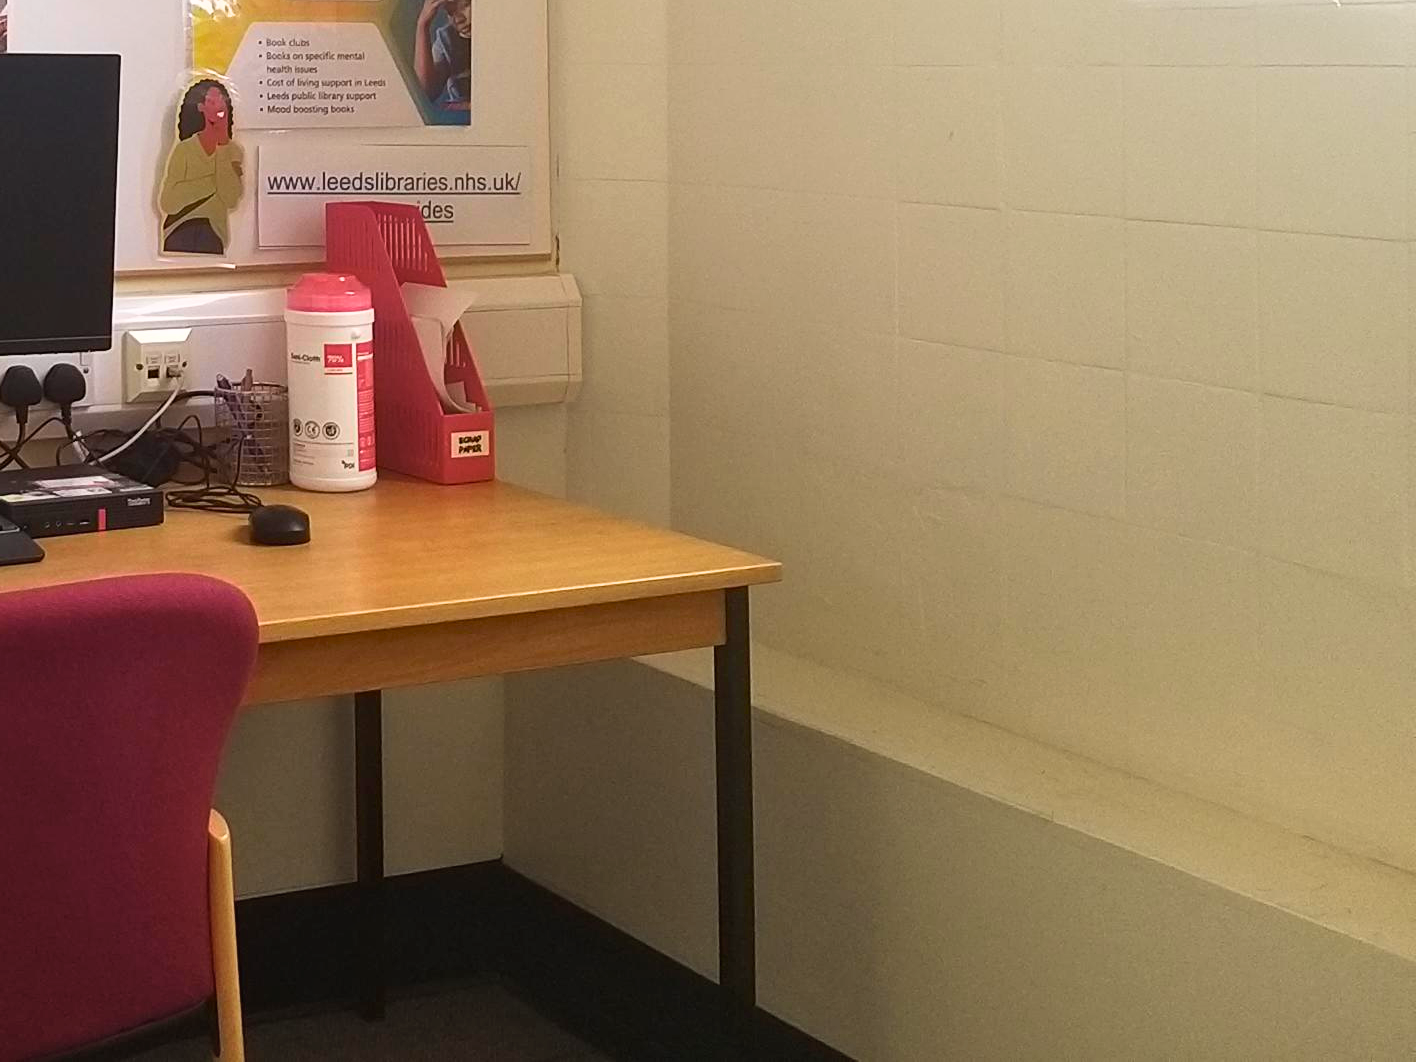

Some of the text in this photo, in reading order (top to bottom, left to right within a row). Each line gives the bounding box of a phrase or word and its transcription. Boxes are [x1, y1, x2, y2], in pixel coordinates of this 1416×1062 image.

[266, 38, 286, 47] Book
[266, 51, 290, 60] Books
[305, 51, 335, 62] specific
[337, 52, 365, 60] mental
[267, 65, 318, 74] health issues
[267, 78, 284, 87] Cost
[286, 78, 295, 87] of
[297, 78, 319, 89] living
[321, 80, 352, 88] support
[364, 79, 386, 87] Leeds
[267, 91, 376, 103] Leeds public library support
[267, 103, 355, 115] Mood boosting books
[268, 172, 521, 191] www.leedslibraries.nhs.uk/
